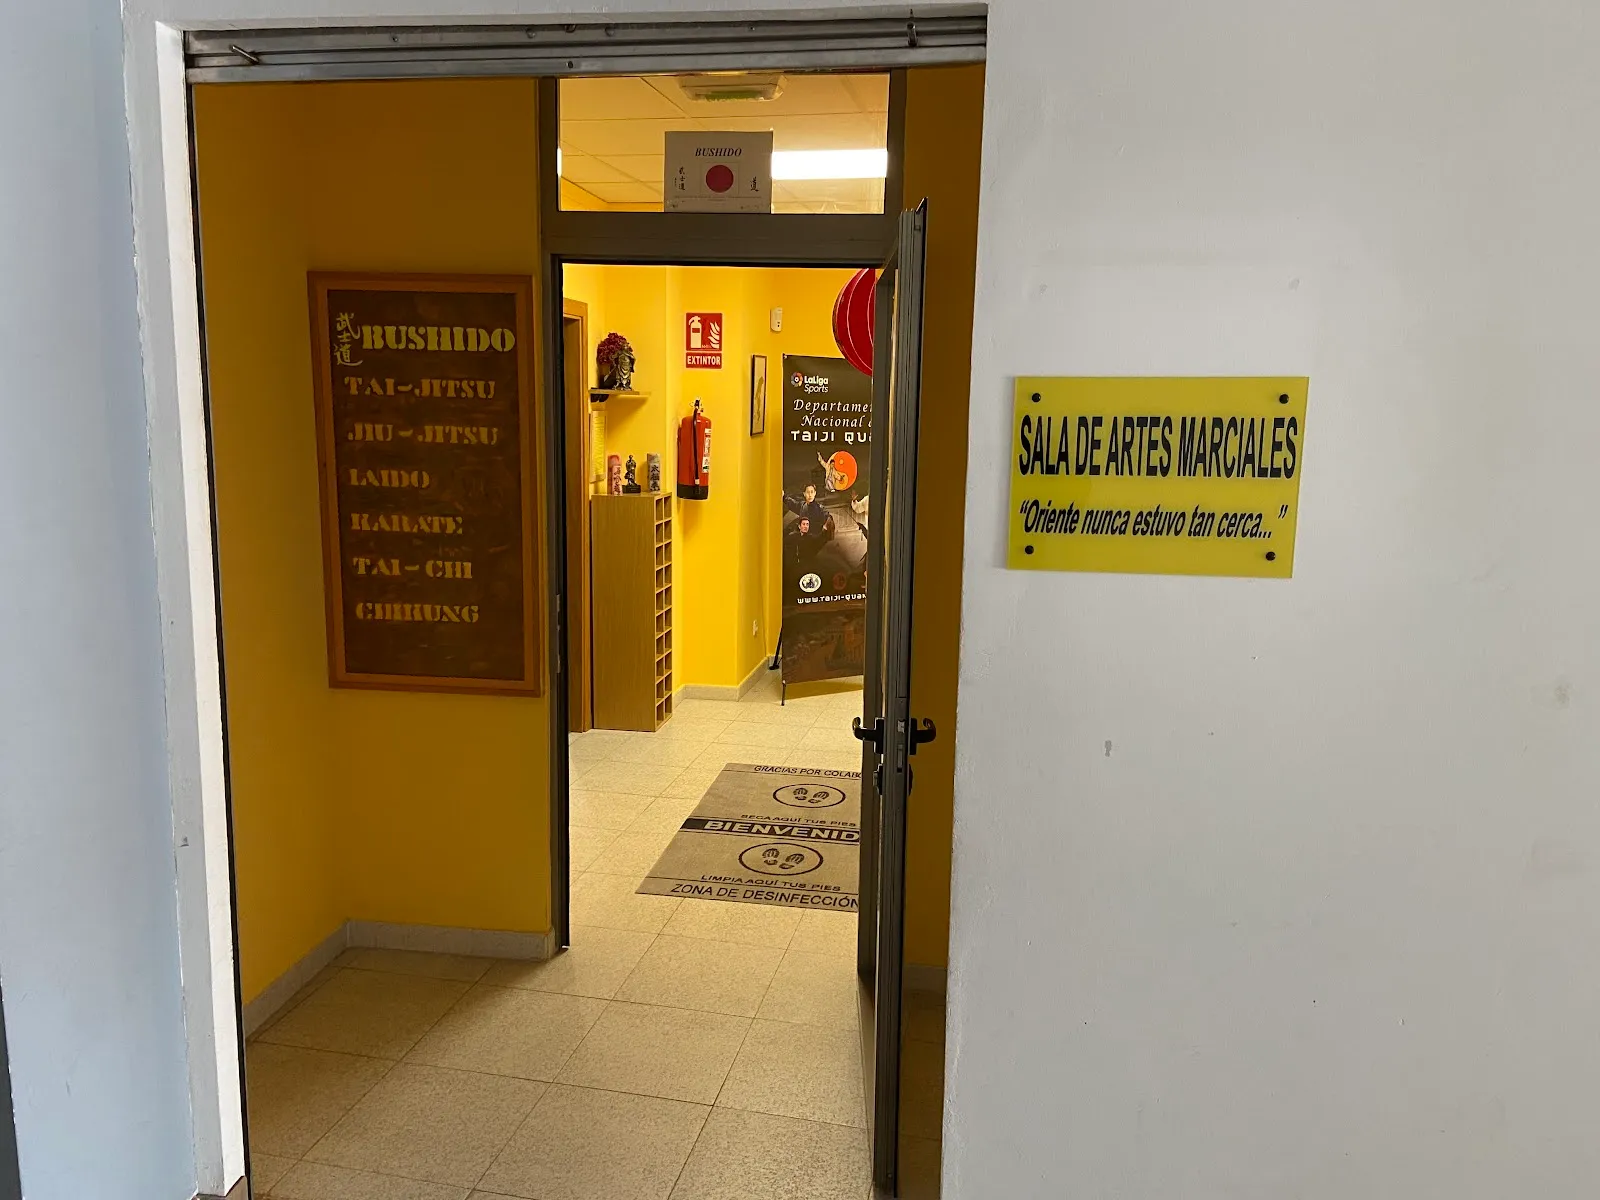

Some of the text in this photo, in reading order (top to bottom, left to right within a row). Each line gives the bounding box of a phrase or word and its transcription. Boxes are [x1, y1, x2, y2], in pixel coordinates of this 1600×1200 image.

[695, 147, 742, 157] BUSHIDO
[361, 325, 516, 352] BUSHIDO
[687, 355, 721, 366] EXTINTOR
[804, 375, 829, 386] LaLiga
[804, 383, 829, 394] Sports
[800, 414, 865, 428] Nacional
[1019, 414, 1298, 479] SALA DE ARTES MARCIALES
[350, 513, 463, 534] KARATE
[1081, 508, 1131, 536] nunca
[1132, 507, 1188, 537] estuvo
[1187, 504, 1216, 538] tan
[754, 765, 798, 774] GRACIAS
[701, 874, 743, 884] LIMPIA
[811, 884, 841, 892] PIES
[670, 883, 713, 895] ZONA
[716, 887, 738, 898] DE
